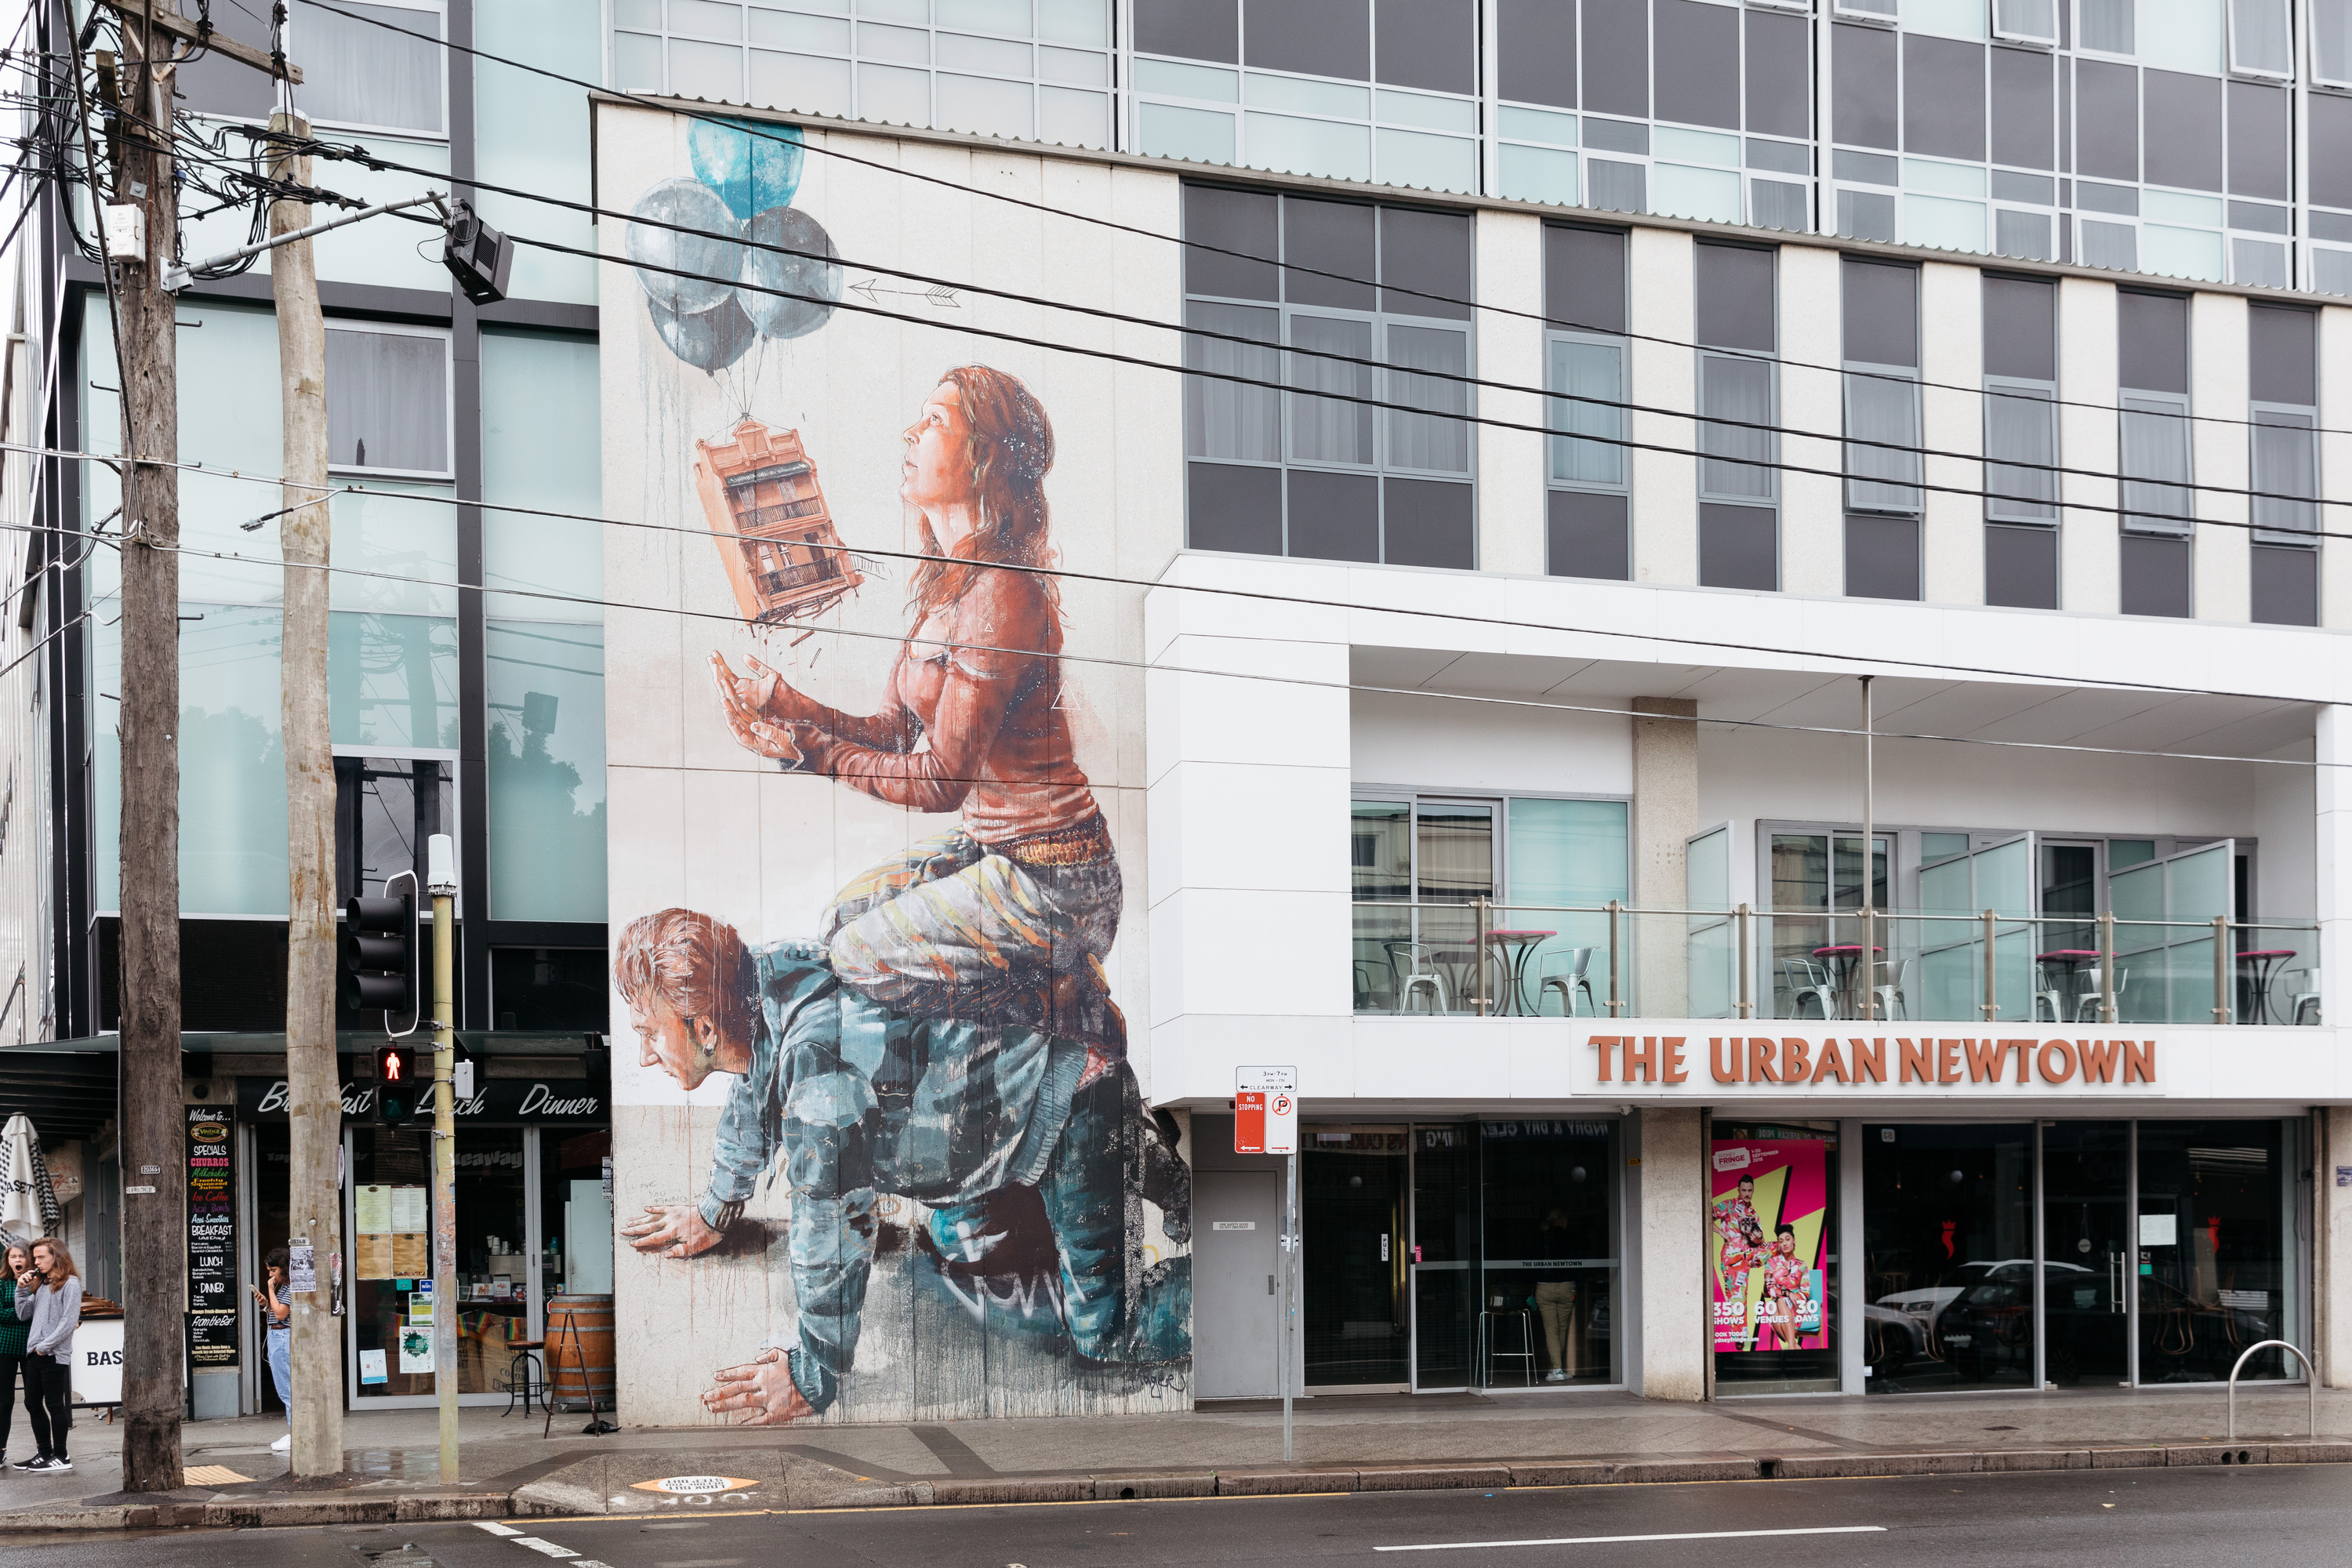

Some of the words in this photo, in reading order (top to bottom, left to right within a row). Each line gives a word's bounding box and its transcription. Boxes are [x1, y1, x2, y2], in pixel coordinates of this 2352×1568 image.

[1587, 1035, 1689, 1083] THE
[1709, 1036, 1888, 1083] URBAN
[1897, 1037, 2156, 1084] NEWTOWN
[518, 1083, 599, 1116] Dinner
[189, 1109, 216, 1121] Welcome
[194, 1145, 227, 1156] SPECIALS
[1751, 1149, 1780, 1159] SEPTEMBER
[191, 1157, 229, 1167] CHURROS
[1719, 1154, 1745, 1165] FRINGE
[191, 1167, 229, 1178] Milkshakes
[631, 1180, 657, 1189] LOVE
[192, 1191, 204, 1201] Ice
[205, 1191, 230, 1201] Coffee
[649, 1190, 666, 1199] YOU
[191, 1203, 207, 1213] Acai
[211, 1203, 230, 1213] Bowls
[191, 1213, 205, 1223] Acai
[205, 1213, 229, 1223] Smoothies
[191, 1225, 233, 1236] BREAKFAST
[199, 1256, 223, 1267] LUNCH
[200, 1282, 225, 1294] DINNER
[1713, 1301, 1745, 1316] 350
[1754, 1300, 1777, 1316] 60
[1795, 1299, 1819, 1315] 30
[191, 1316, 209, 1327] From
[209, 1315, 221, 1327] the
[219, 1315, 236, 1327] Bar!
[1754, 1315, 1790, 1324] VENUES
[1795, 1314, 1819, 1323] DAYS
[87, 1351, 123, 1366] BAS
